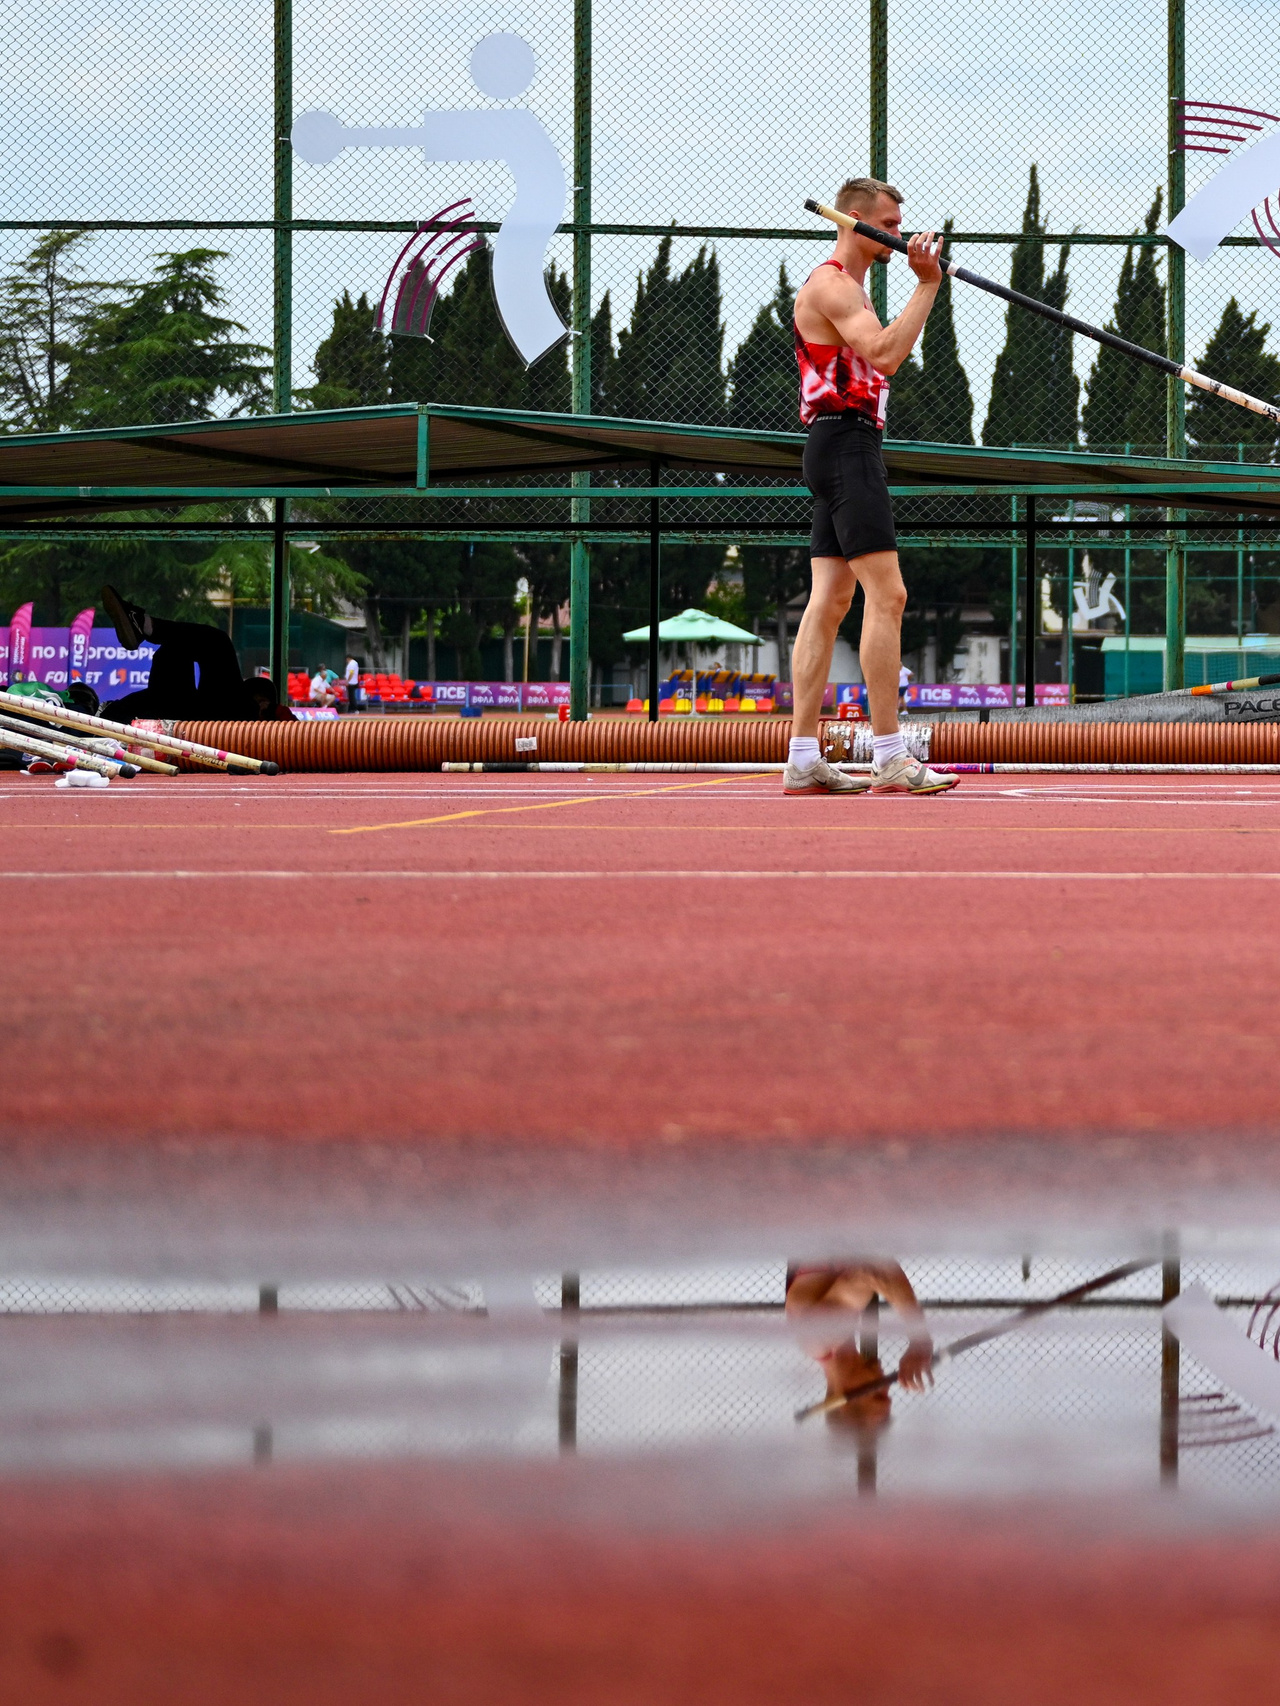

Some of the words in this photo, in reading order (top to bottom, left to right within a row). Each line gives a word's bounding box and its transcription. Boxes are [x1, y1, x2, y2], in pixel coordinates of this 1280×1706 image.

[32, 646, 56, 660] ПО
[72, 633, 86, 667] ПСБ
[44, 670, 104, 684] FOET
[129, 671, 151, 684] ПС
[436, 686, 467, 700] ПСБ
[920, 688, 952, 701] ПСБ
[472, 695, 495, 704] ВФЛА
[498, 695, 521, 704] ВФЛА
[527, 696, 550, 704] ВФЛА
[553, 695, 571, 703] ВФЛ
[958, 697, 982, 705] ВФЛА
[984, 697, 1009, 705] ВФЛА
